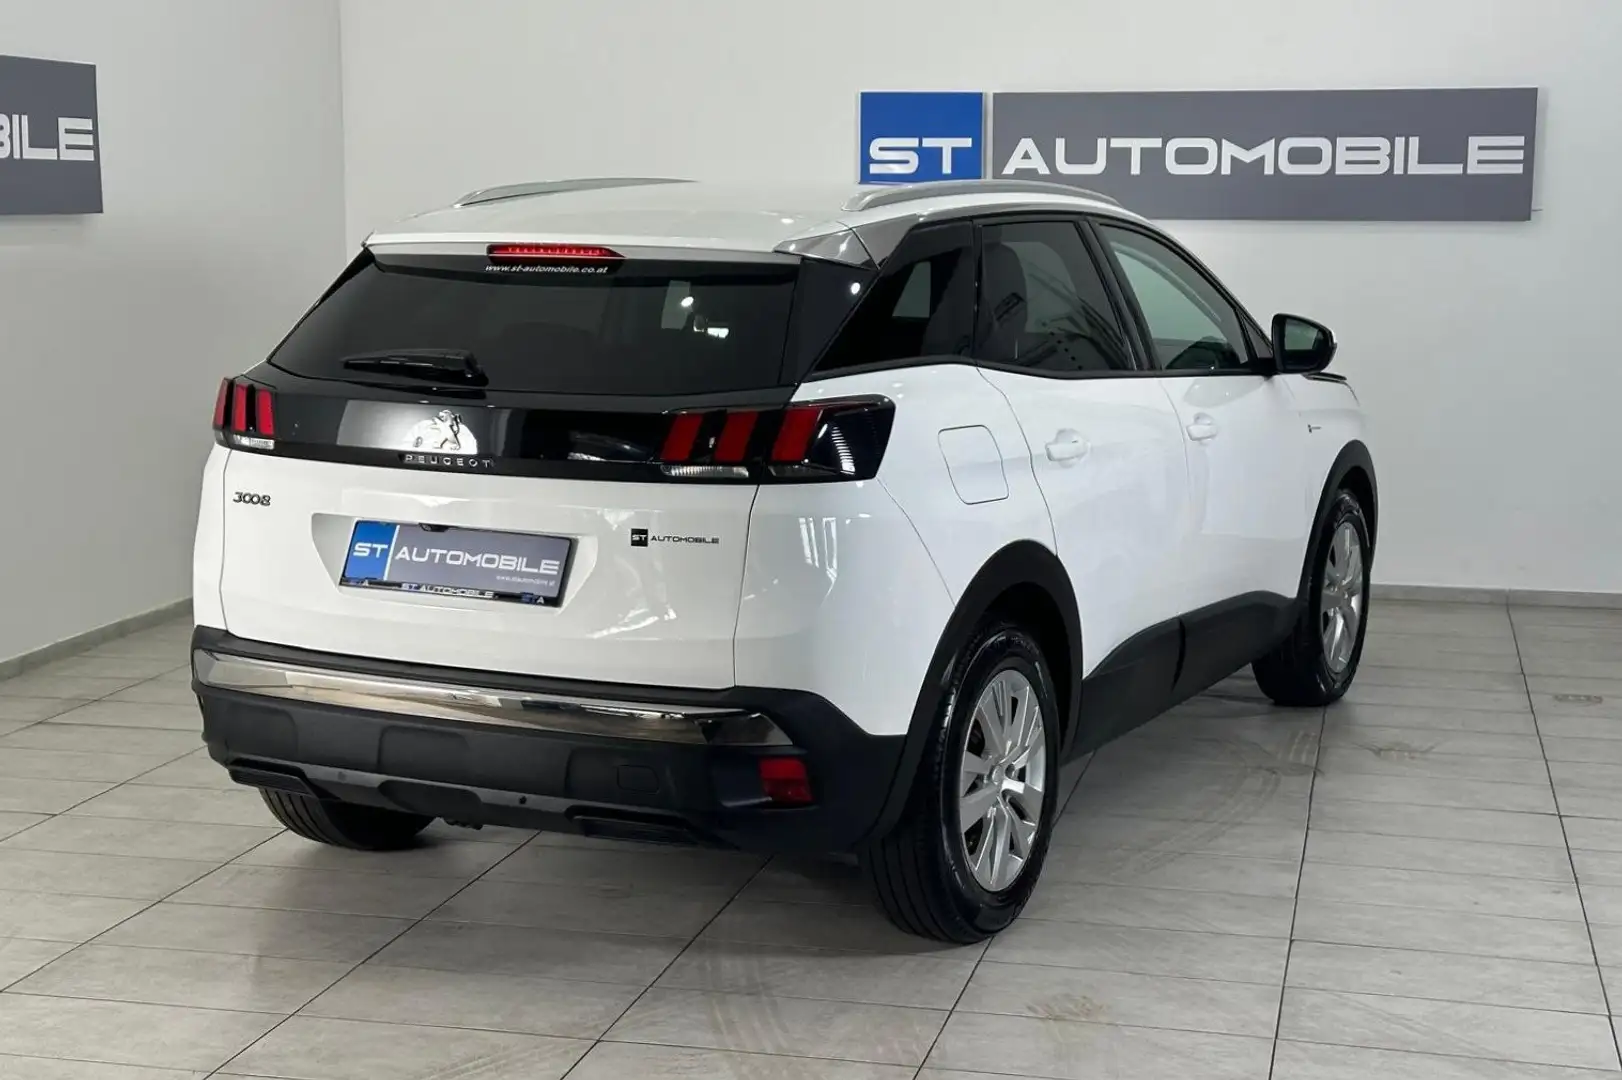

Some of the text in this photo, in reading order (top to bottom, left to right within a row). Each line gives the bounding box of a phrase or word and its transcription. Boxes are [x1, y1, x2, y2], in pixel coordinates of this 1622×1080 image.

[869, 135, 1525, 176] ST AUTOMOBILE
[485, 264, 609, 274] www.st-automobile.co.at
[404, 454, 491, 468] PEUGEOT
[232, 491, 271, 506] 3008
[651, 535, 720, 544] AUTOMOBILE
[353, 542, 560, 576] ST AUTOMOBILE
[401, 583, 495, 599] ST AUTOMOBILE
